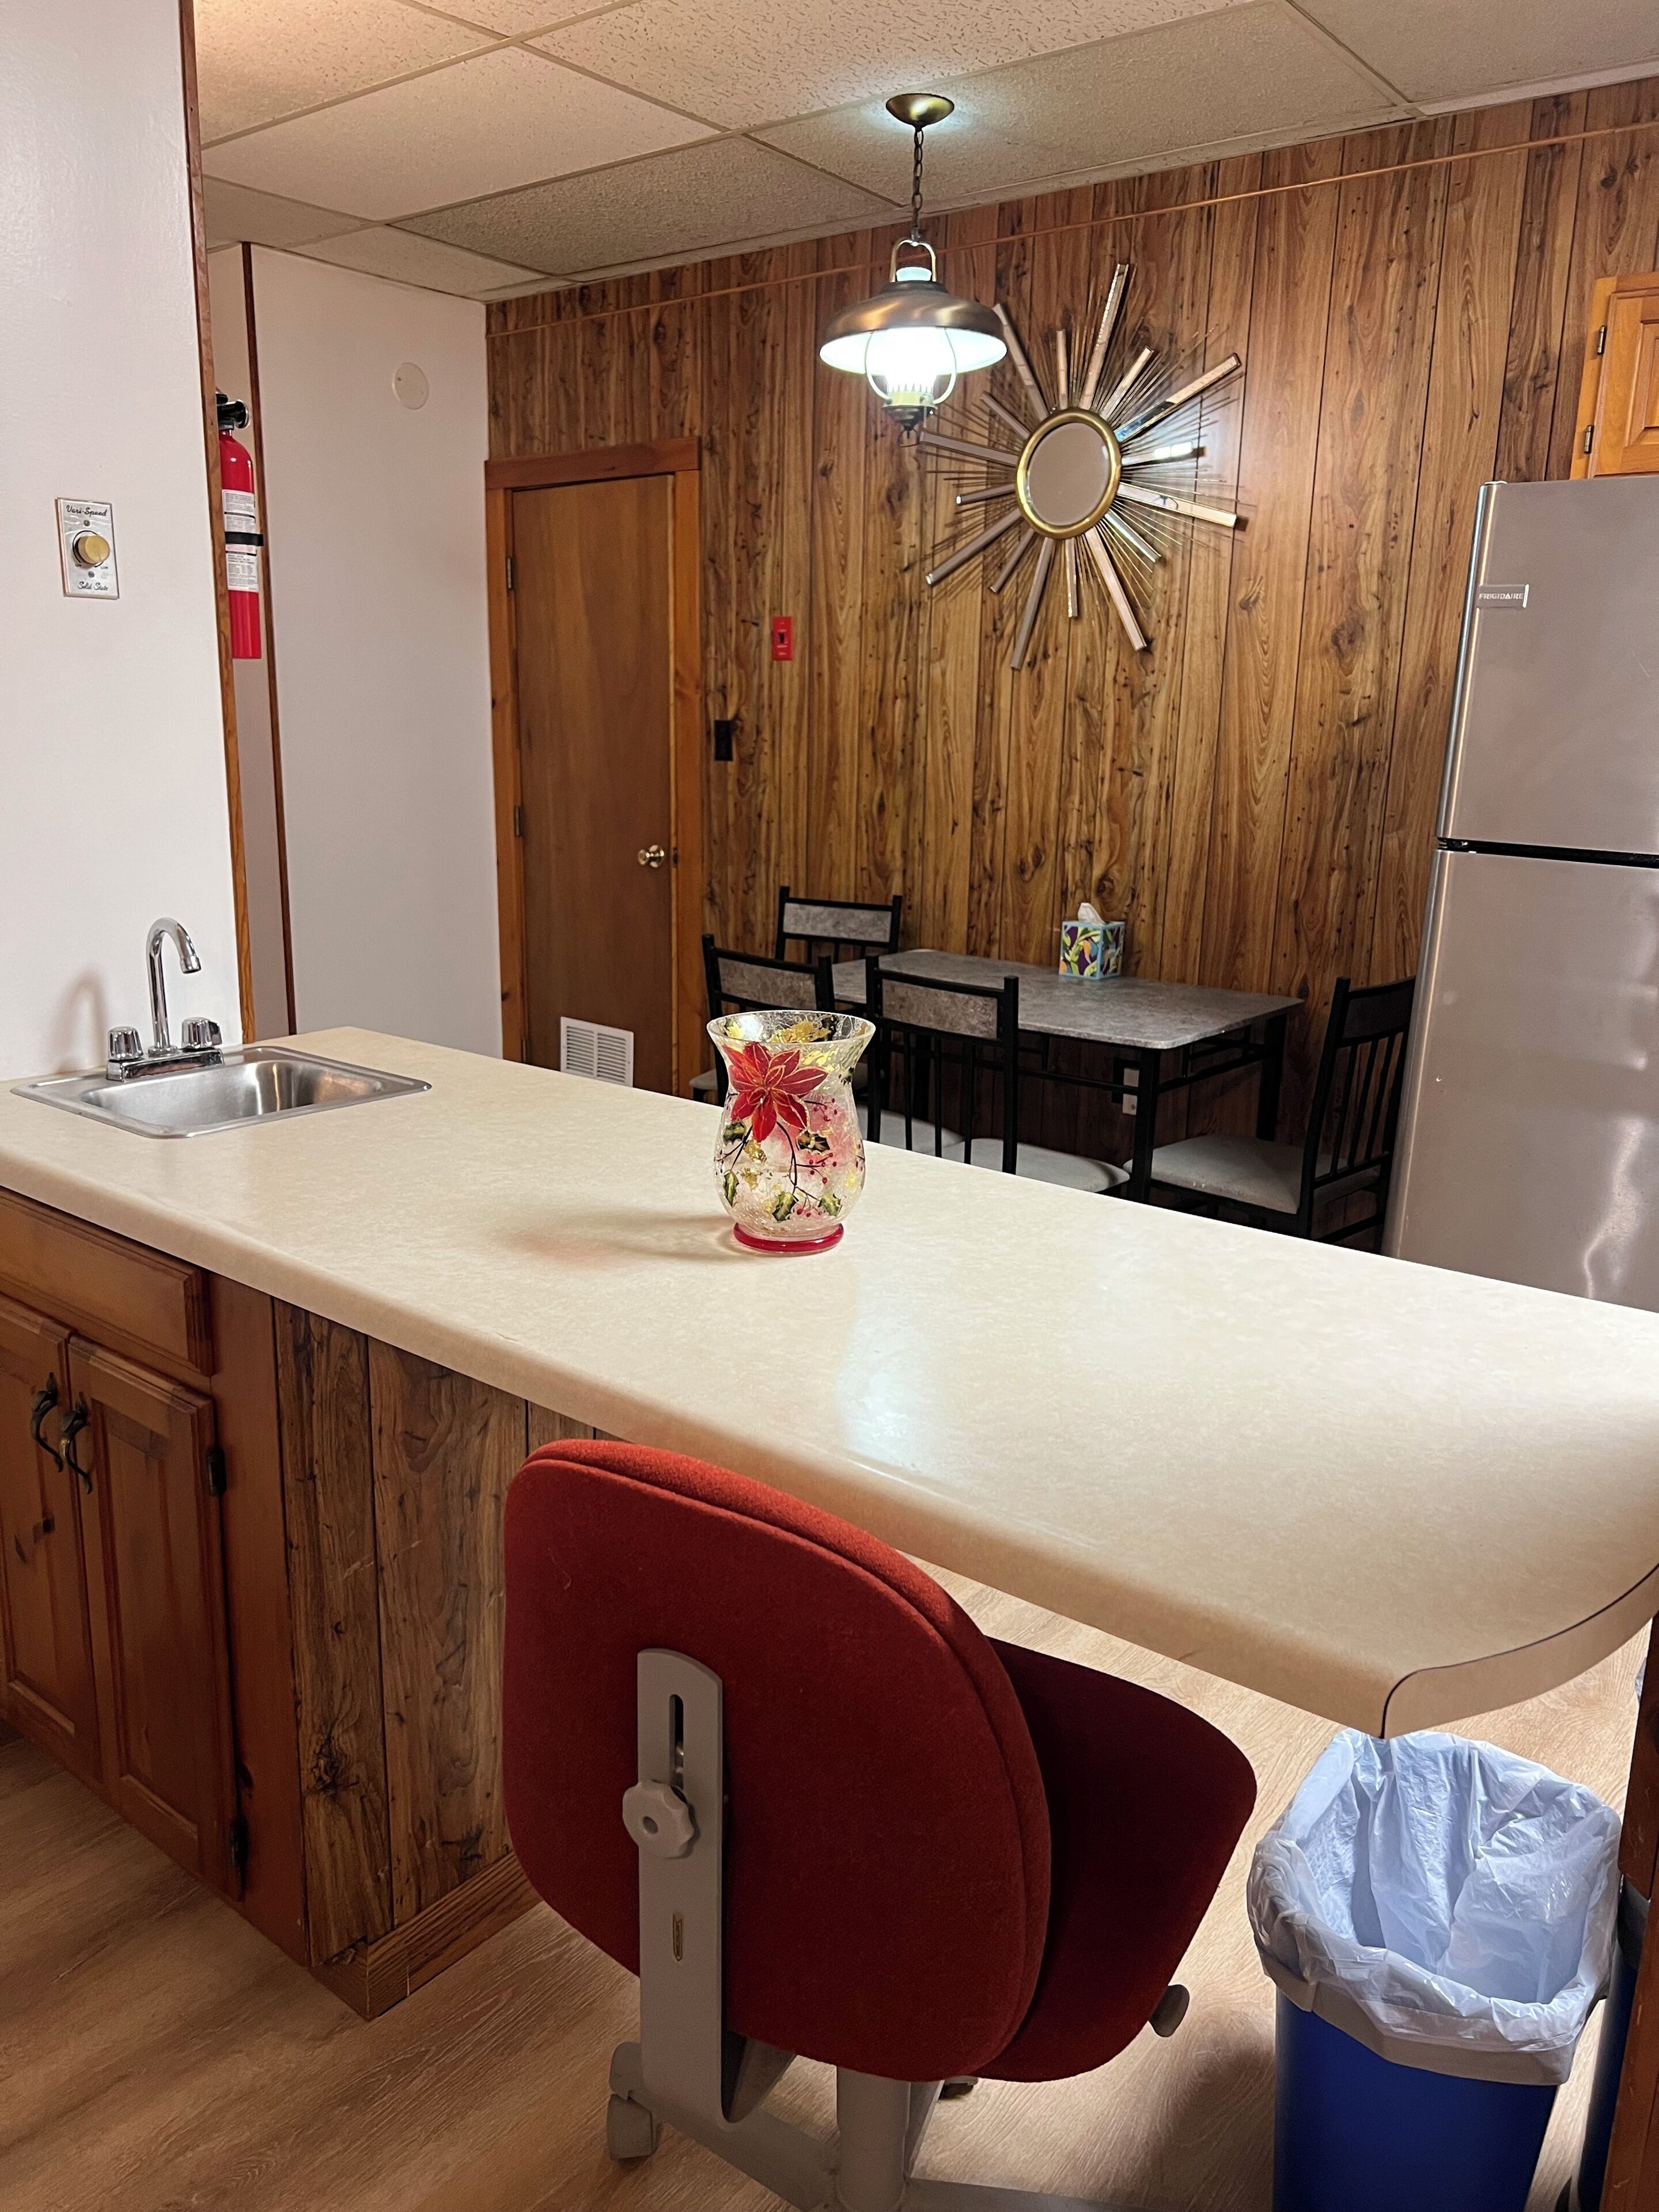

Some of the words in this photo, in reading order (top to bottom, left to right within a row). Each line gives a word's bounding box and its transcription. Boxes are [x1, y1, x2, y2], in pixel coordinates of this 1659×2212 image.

[66, 505, 107, 517] Vari-Speed
[78, 581, 92, 589] Solid
[93, 582, 108, 590] State
